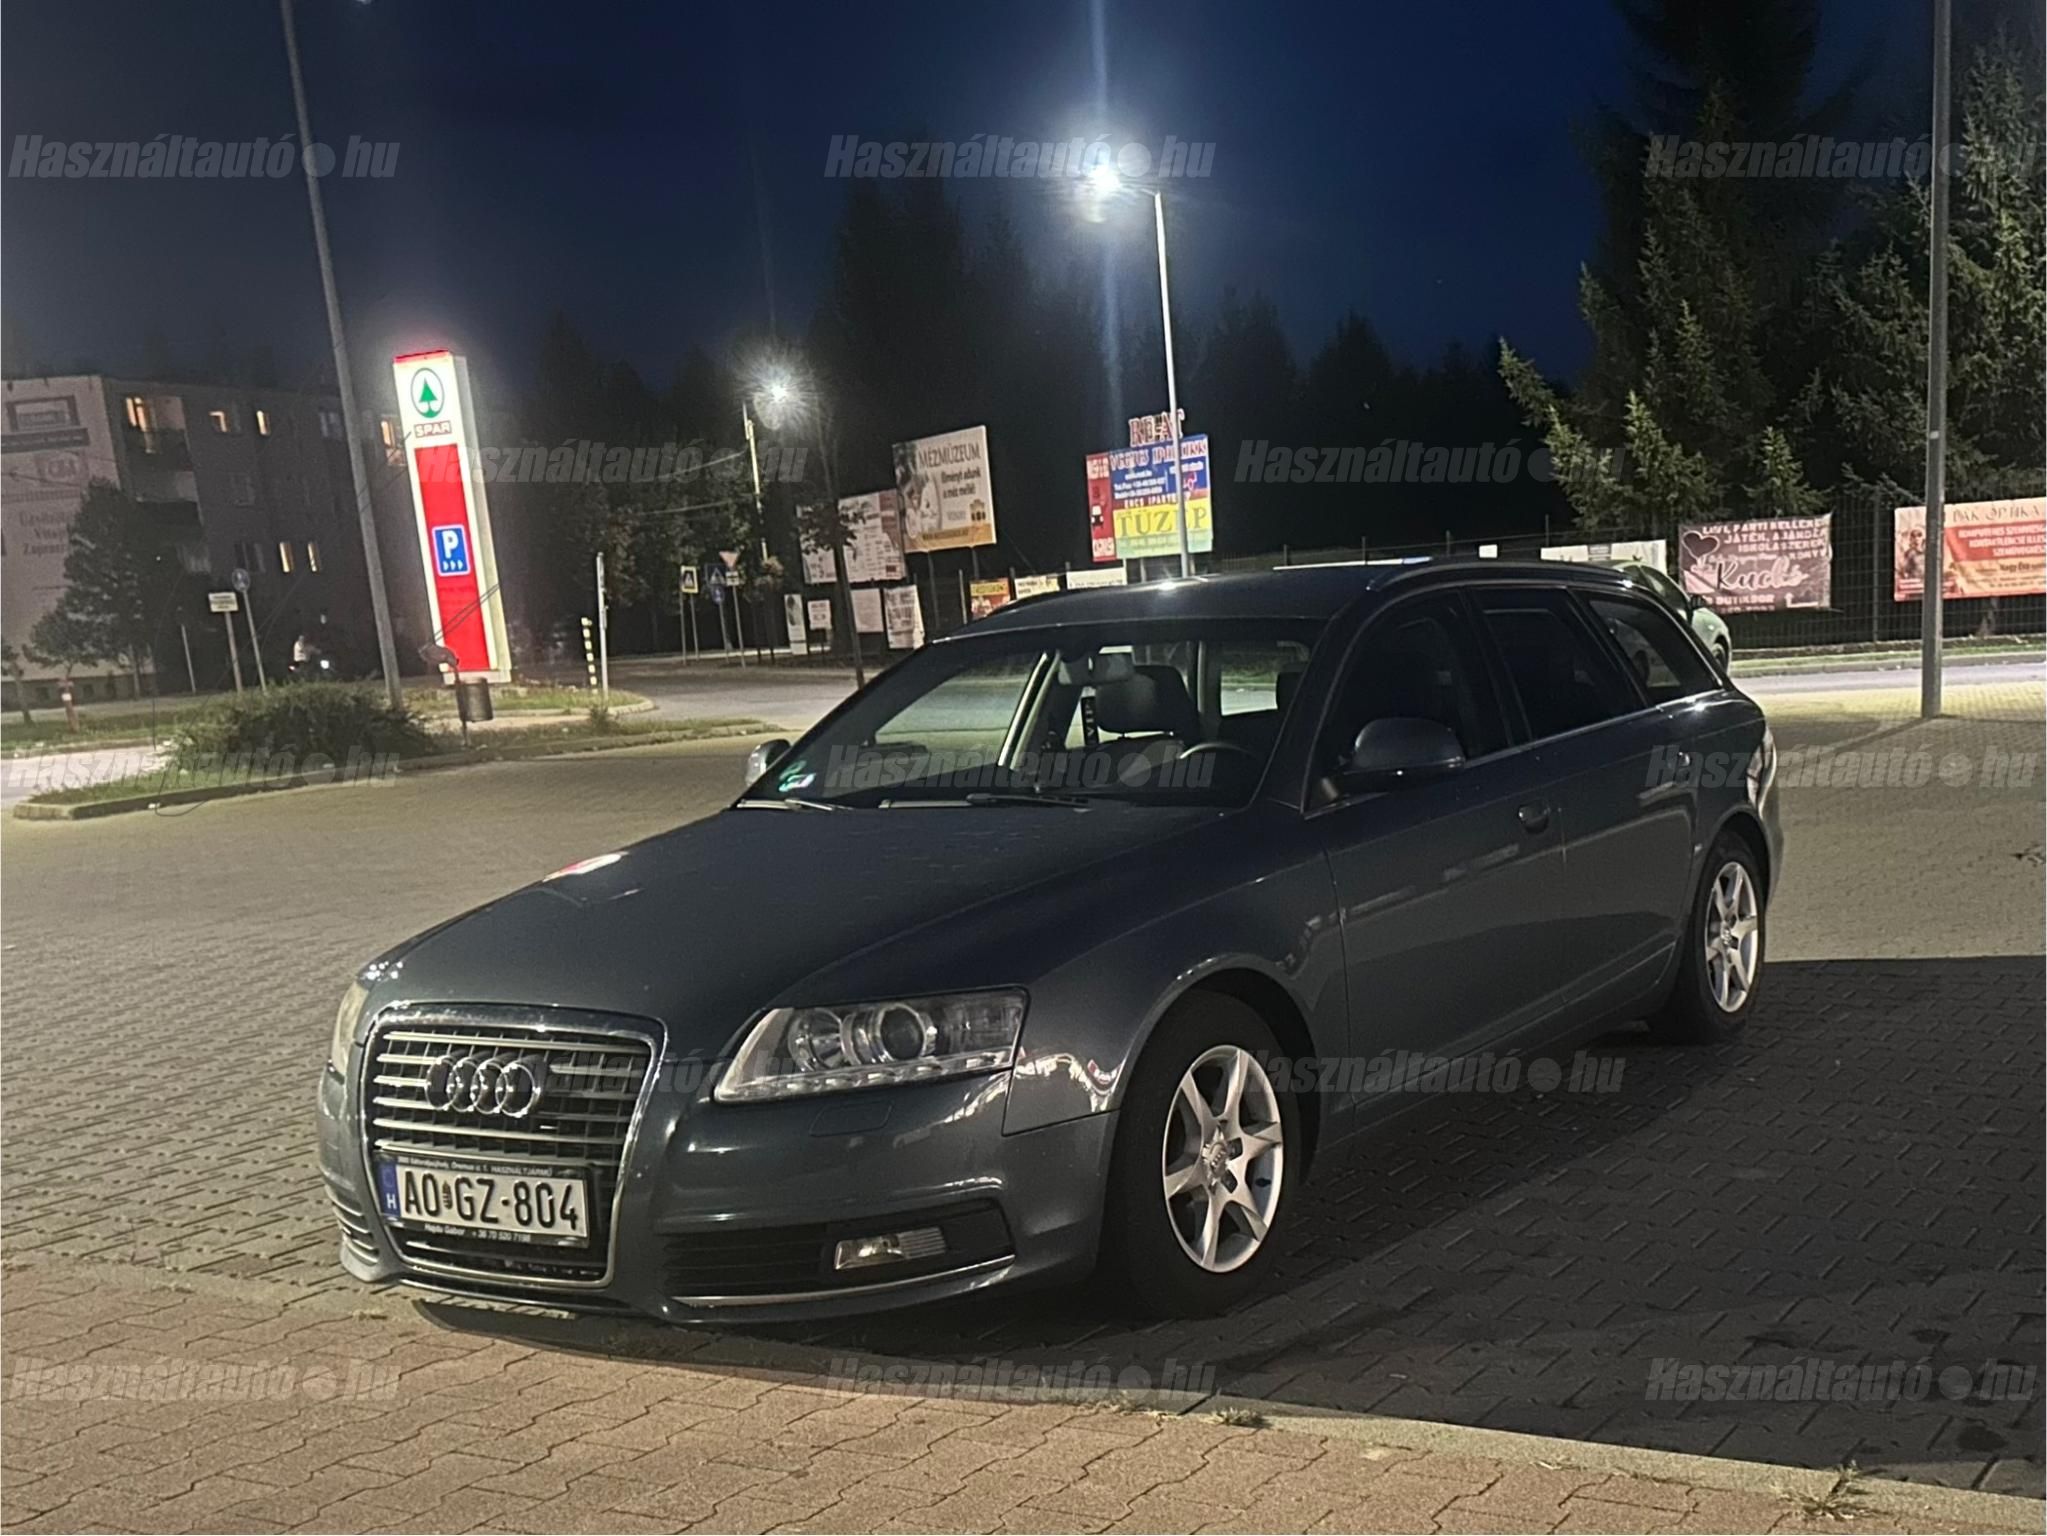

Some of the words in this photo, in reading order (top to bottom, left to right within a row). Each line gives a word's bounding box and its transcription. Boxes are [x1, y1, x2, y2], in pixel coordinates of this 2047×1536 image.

[415, 421, 451, 438] SPAR
[1117, 506, 1207, 537] TÜZP
[441, 530, 459, 559] P
[386, 1193, 398, 1210] H
